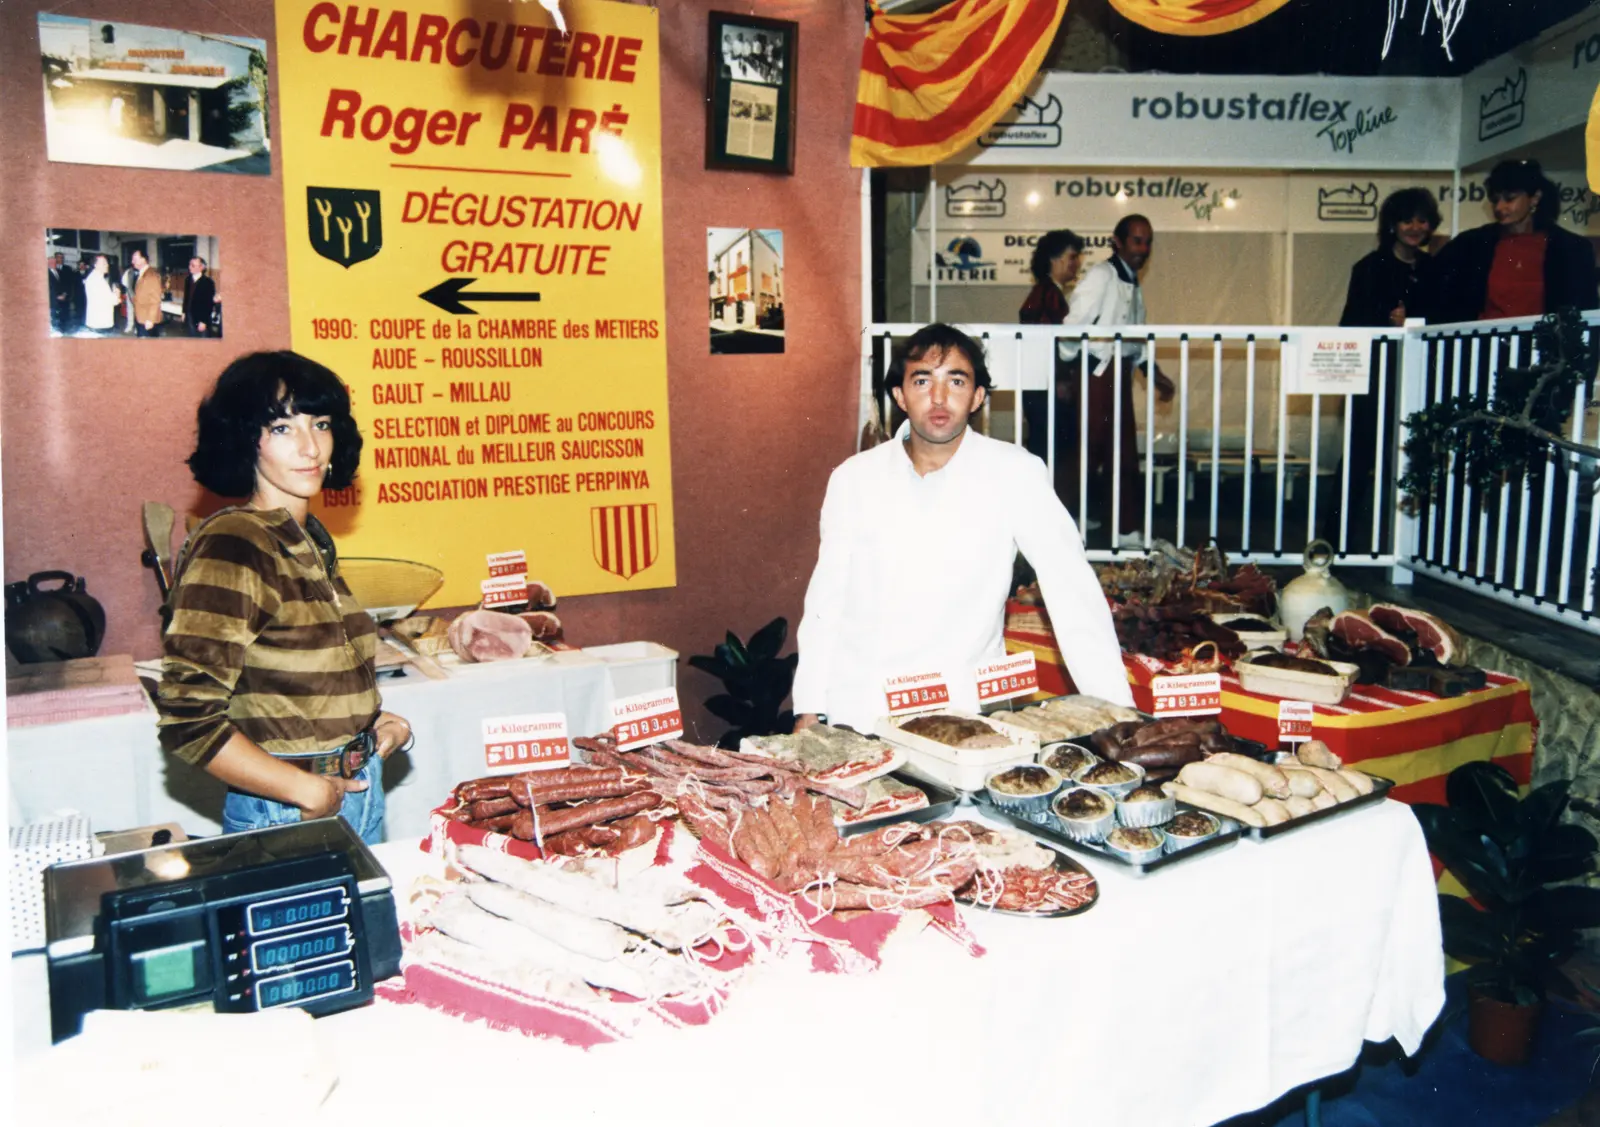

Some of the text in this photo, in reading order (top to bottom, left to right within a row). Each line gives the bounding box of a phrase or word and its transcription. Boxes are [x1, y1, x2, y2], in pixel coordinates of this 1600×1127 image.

[303, 2, 643, 83] CHARCUTERIE
[320, 88, 482, 154] Roger
[1131, 92, 1351, 122] robustaflex
[1316, 105, 1398, 153] Topline
[1055, 176, 1210, 198] robustaflex
[401, 187, 642, 231] DÉGUSTATION
[441, 240, 611, 275] GRATUITE
[312, 319, 659, 341] 1990: COUPE de la CHAMBRE des METIERS
[372, 348, 417, 370] AUDE
[442, 347, 543, 369] ROUSSILLON
[372, 383, 425, 405] GAULT
[450, 381, 511, 403] MILLAU
[373, 410, 655, 439] SELECTION et DIPLOME au CONCOURS
[374, 438, 644, 469] NATIONAL du MEILLEUR SAUCISSON
[377, 478, 488, 504] ASSOCIATION
[493, 474, 571, 498] PRESTIGE
[576, 470, 650, 493] PERPINYA
[1167, 680, 1217, 689] Kilogramme
[614, 696, 675, 716] Le Kilogramme
[487, 722, 563, 735] Le Kilogramme
